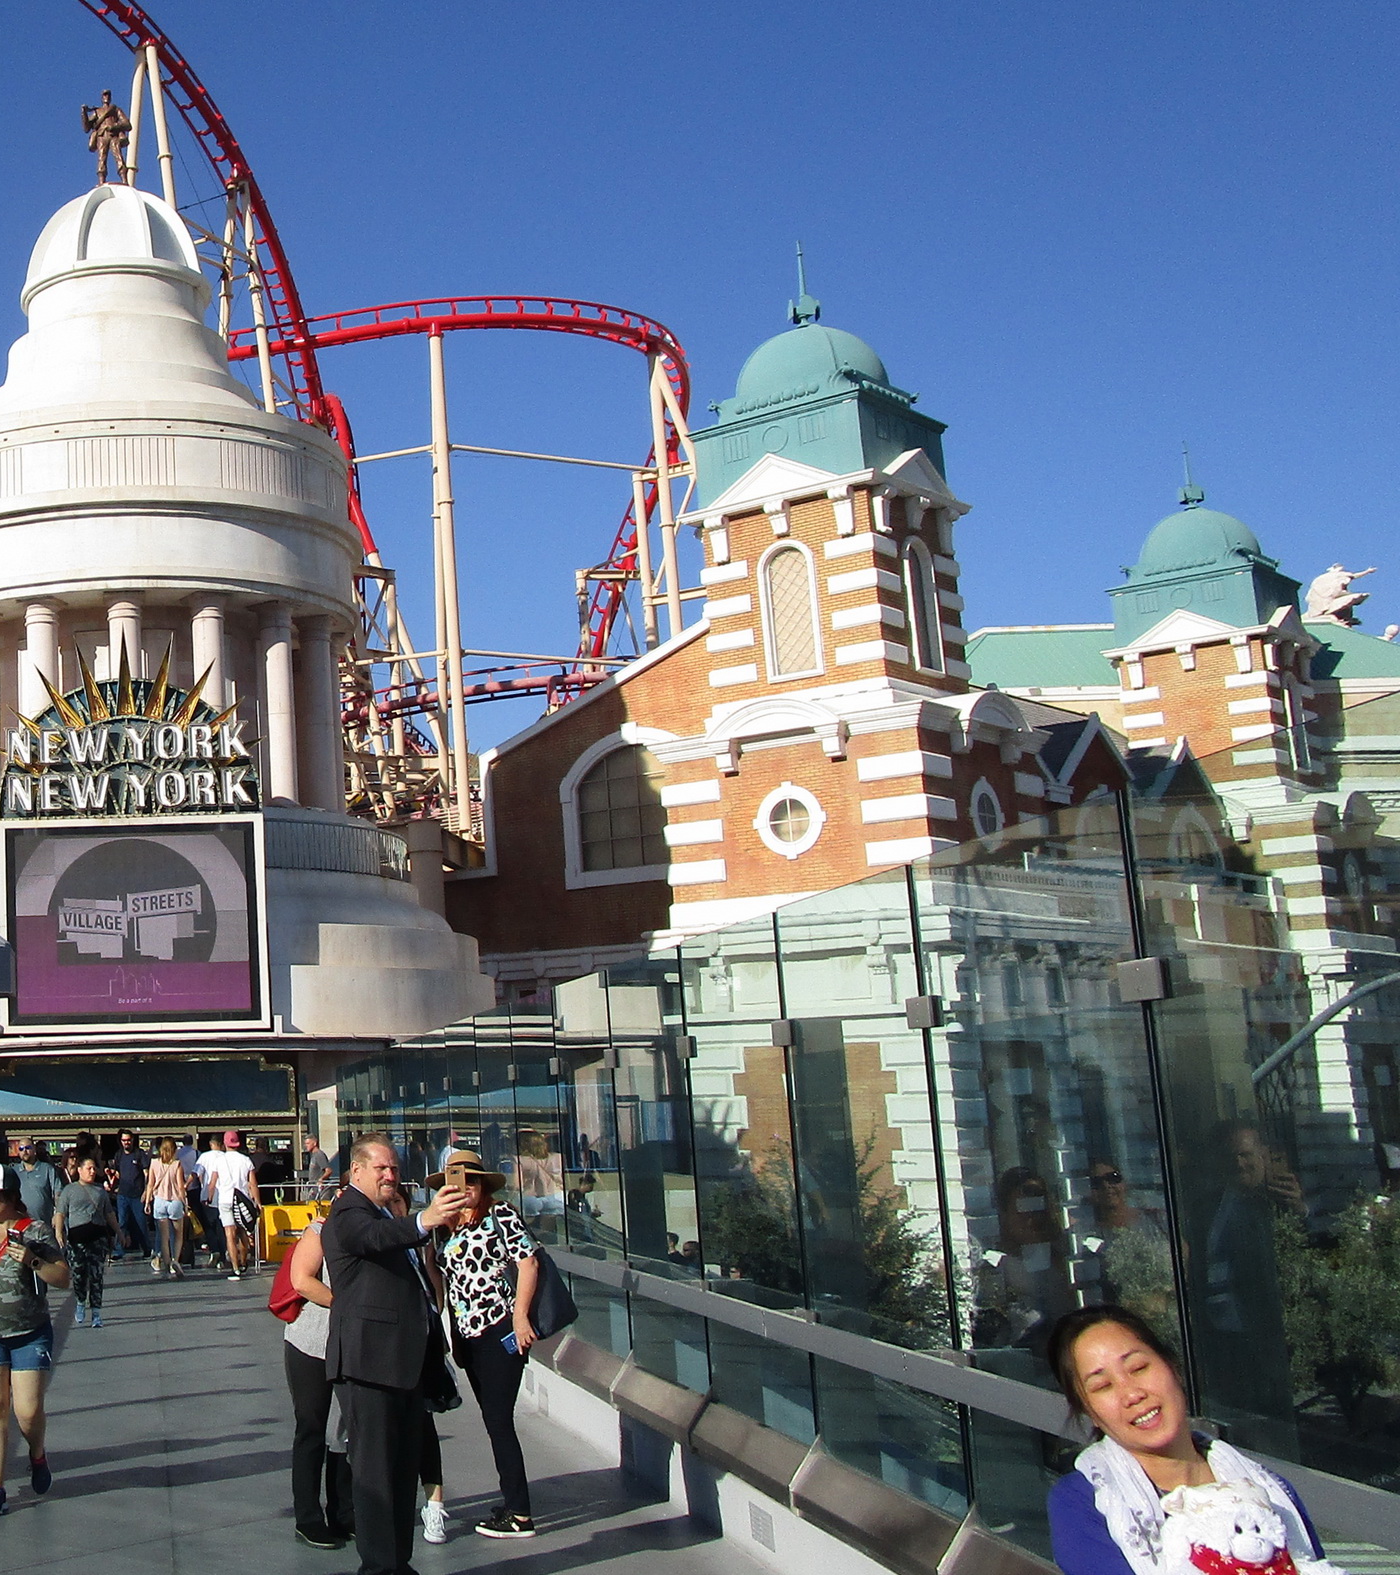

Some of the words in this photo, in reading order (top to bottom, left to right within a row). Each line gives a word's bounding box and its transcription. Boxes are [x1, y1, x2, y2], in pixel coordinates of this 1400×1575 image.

[5, 726, 108, 765] NEW
[125, 720, 253, 762] YORK
[6, 771, 110, 812] NEW
[126, 767, 255, 808] YORK
[132, 891, 194, 913] STREETS
[63, 912, 123, 931] VILLAGE
